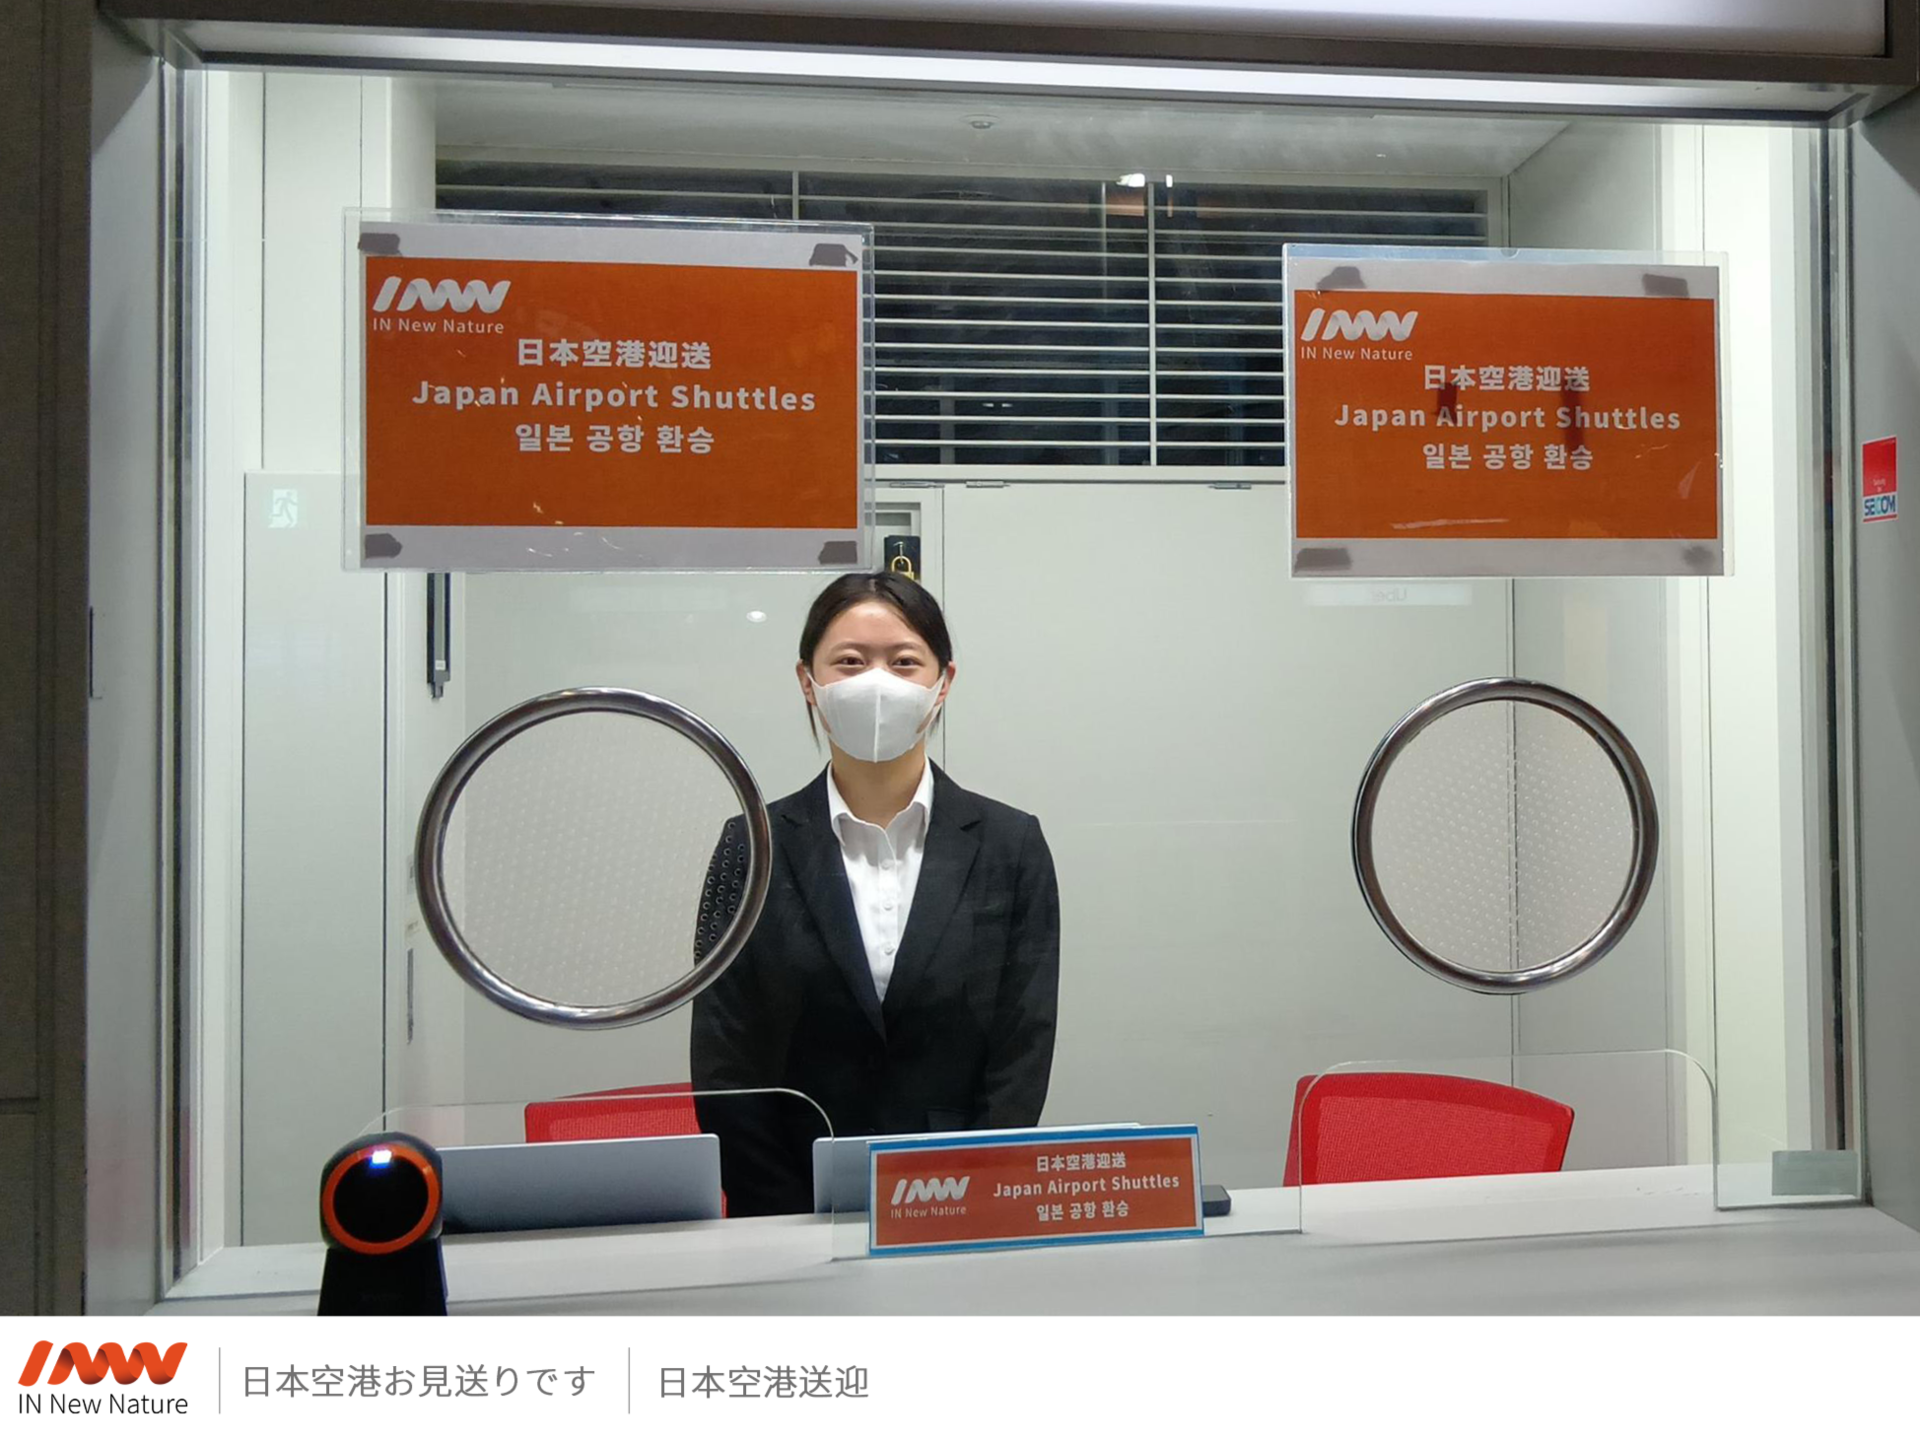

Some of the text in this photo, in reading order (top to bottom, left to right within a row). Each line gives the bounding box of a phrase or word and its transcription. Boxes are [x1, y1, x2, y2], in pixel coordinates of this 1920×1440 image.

[374, 318, 504, 333] IN New Nature
[519, 339, 710, 369] 日本空港迎送
[1302, 347, 1412, 360] IN New Nature
[1425, 365, 1589, 391] 日本空港迎送
[413, 381, 814, 412] Japan Airport Shuttles
[1335, 404, 1679, 432] Japan Airport Shuttles
[516, 424, 714, 453] 일본 공항 환승
[1423, 444, 1592, 470] 일본 공항 환승
[1864, 496, 1896, 516] SECOM
[1037, 1152, 1126, 1172] 日本空港迎送
[994, 1174, 1179, 1199] Japan Airport Shuttles
[891, 1206, 966, 1218] IN New Nature
[1037, 1201, 1128, 1221] 일본 공항 환승
